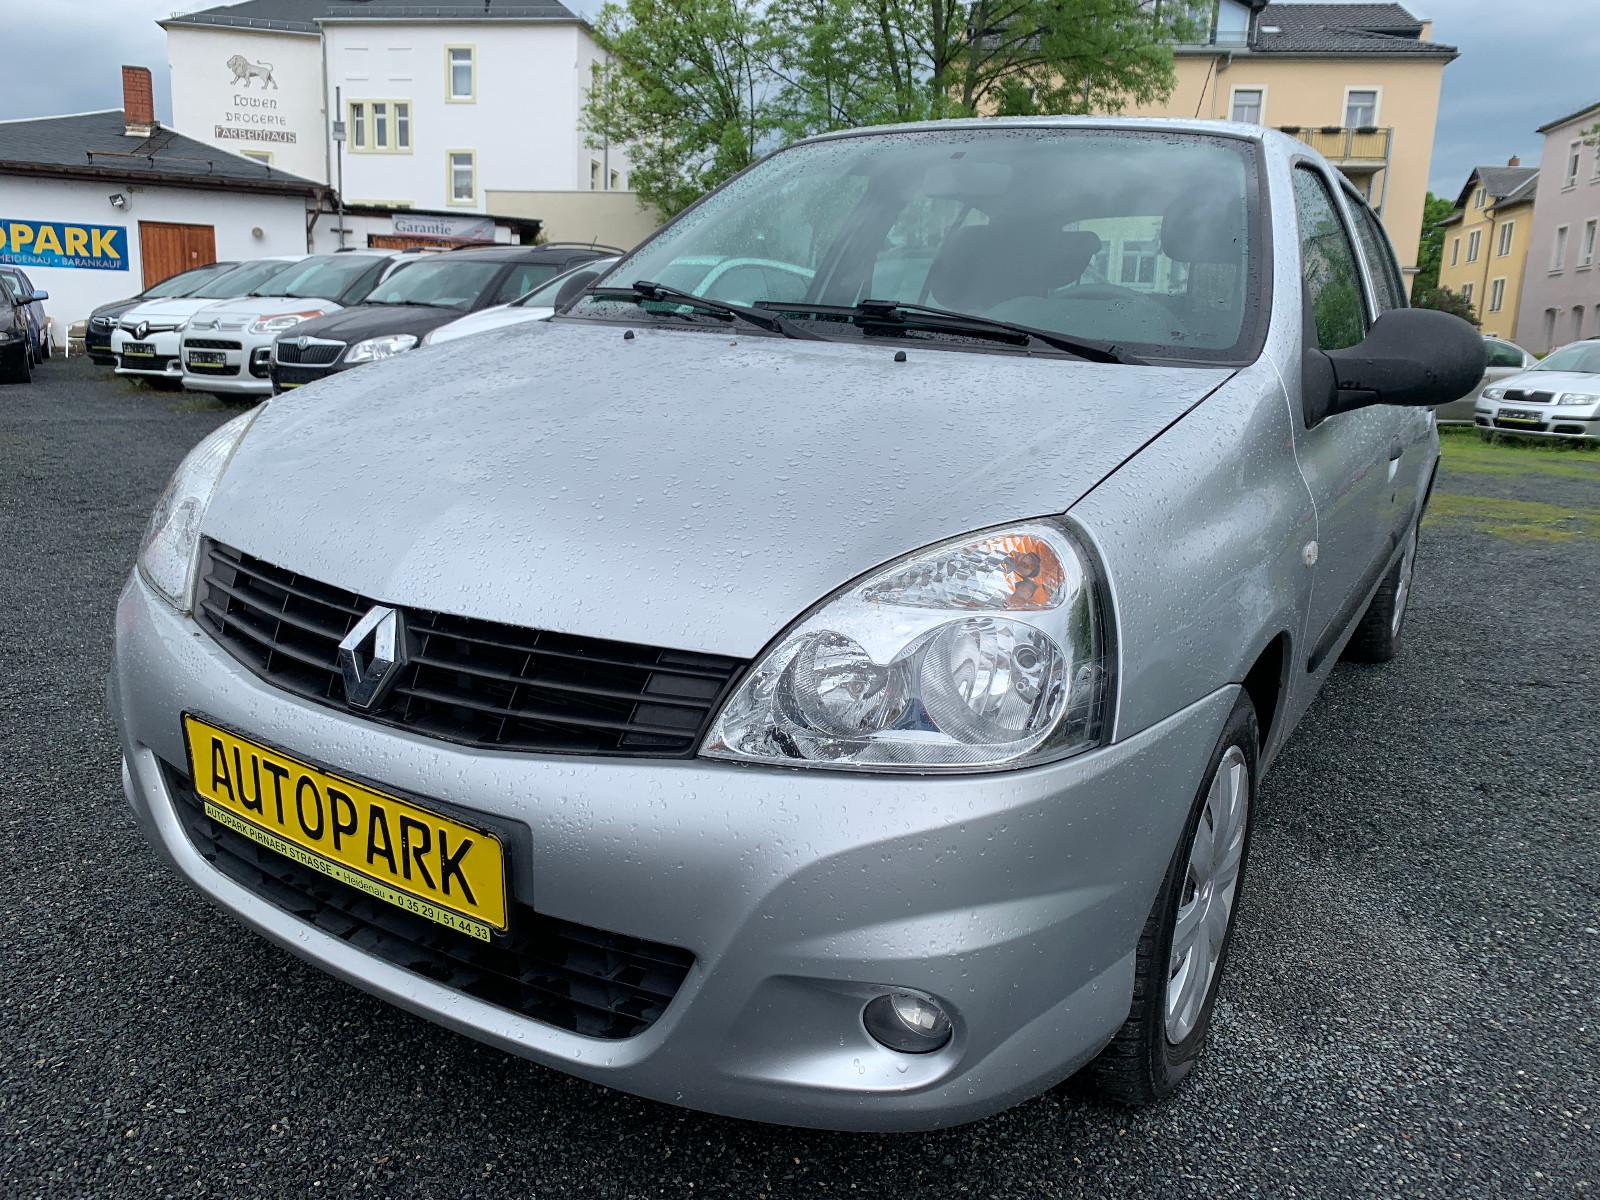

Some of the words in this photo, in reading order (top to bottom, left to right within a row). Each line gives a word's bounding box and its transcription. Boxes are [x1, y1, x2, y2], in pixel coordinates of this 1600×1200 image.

[0, 223, 120, 258] PARK
[395, 221, 452, 235] Garantie
[211, 736, 477, 907] AUTOPARK
[206, 805, 248, 836] AUTOPARK
[249, 828, 288, 855] PIRNAER
[289, 847, 333, 875] STRASSE
[343, 872, 386, 898] Heidenau
[407, 899, 419, 912] 35
[421, 905, 434, 918] 29
[443, 913, 456, 927] 51
[458, 921, 472, 934] 44
[474, 926, 488, 940] 33
